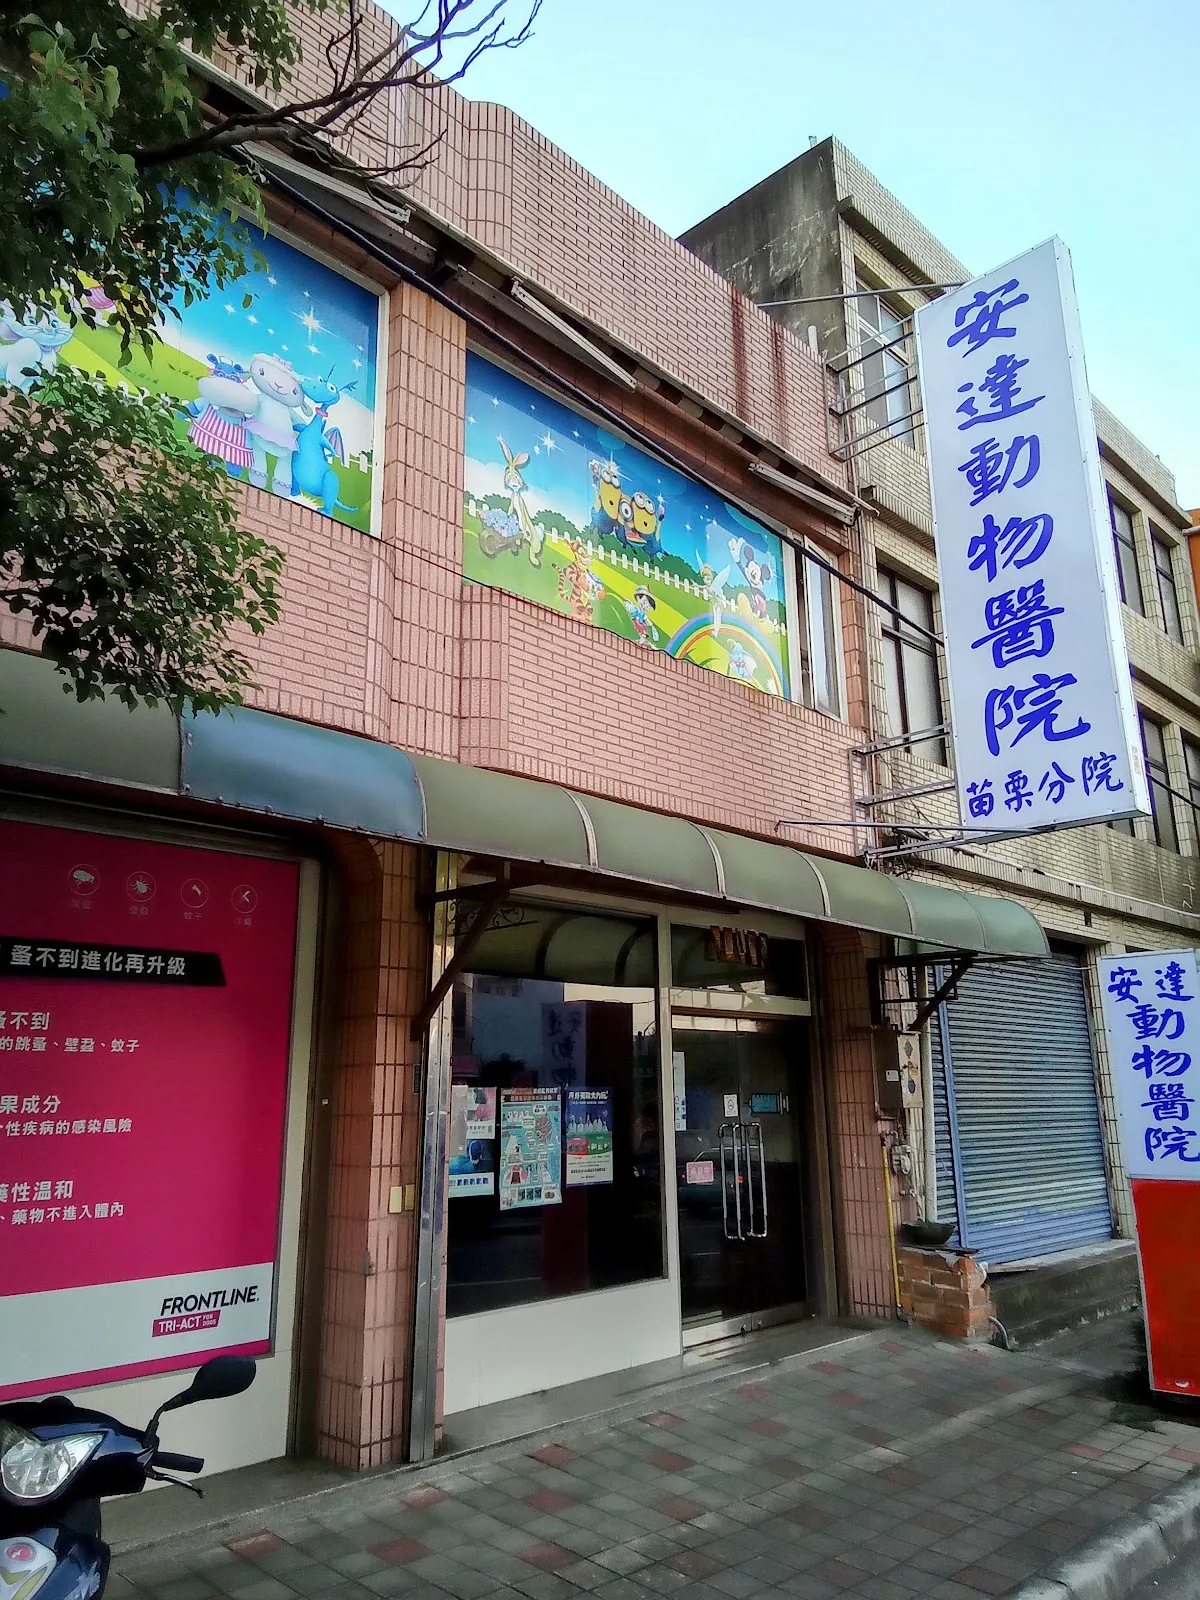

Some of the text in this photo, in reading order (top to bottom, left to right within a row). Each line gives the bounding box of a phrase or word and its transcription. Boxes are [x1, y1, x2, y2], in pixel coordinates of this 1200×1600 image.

[946, 277, 1091, 757] 安達動物醫院
[966, 751, 1124, 819] 苗栗分院
[10, 944, 187, 977] 蚤不到進化再升級
[0, 1094, 62, 1115] 果成分
[0, 1117, 133, 1137] 性疾病的感染風險
[159, 1315, 203, 1334] TRI-ACT
